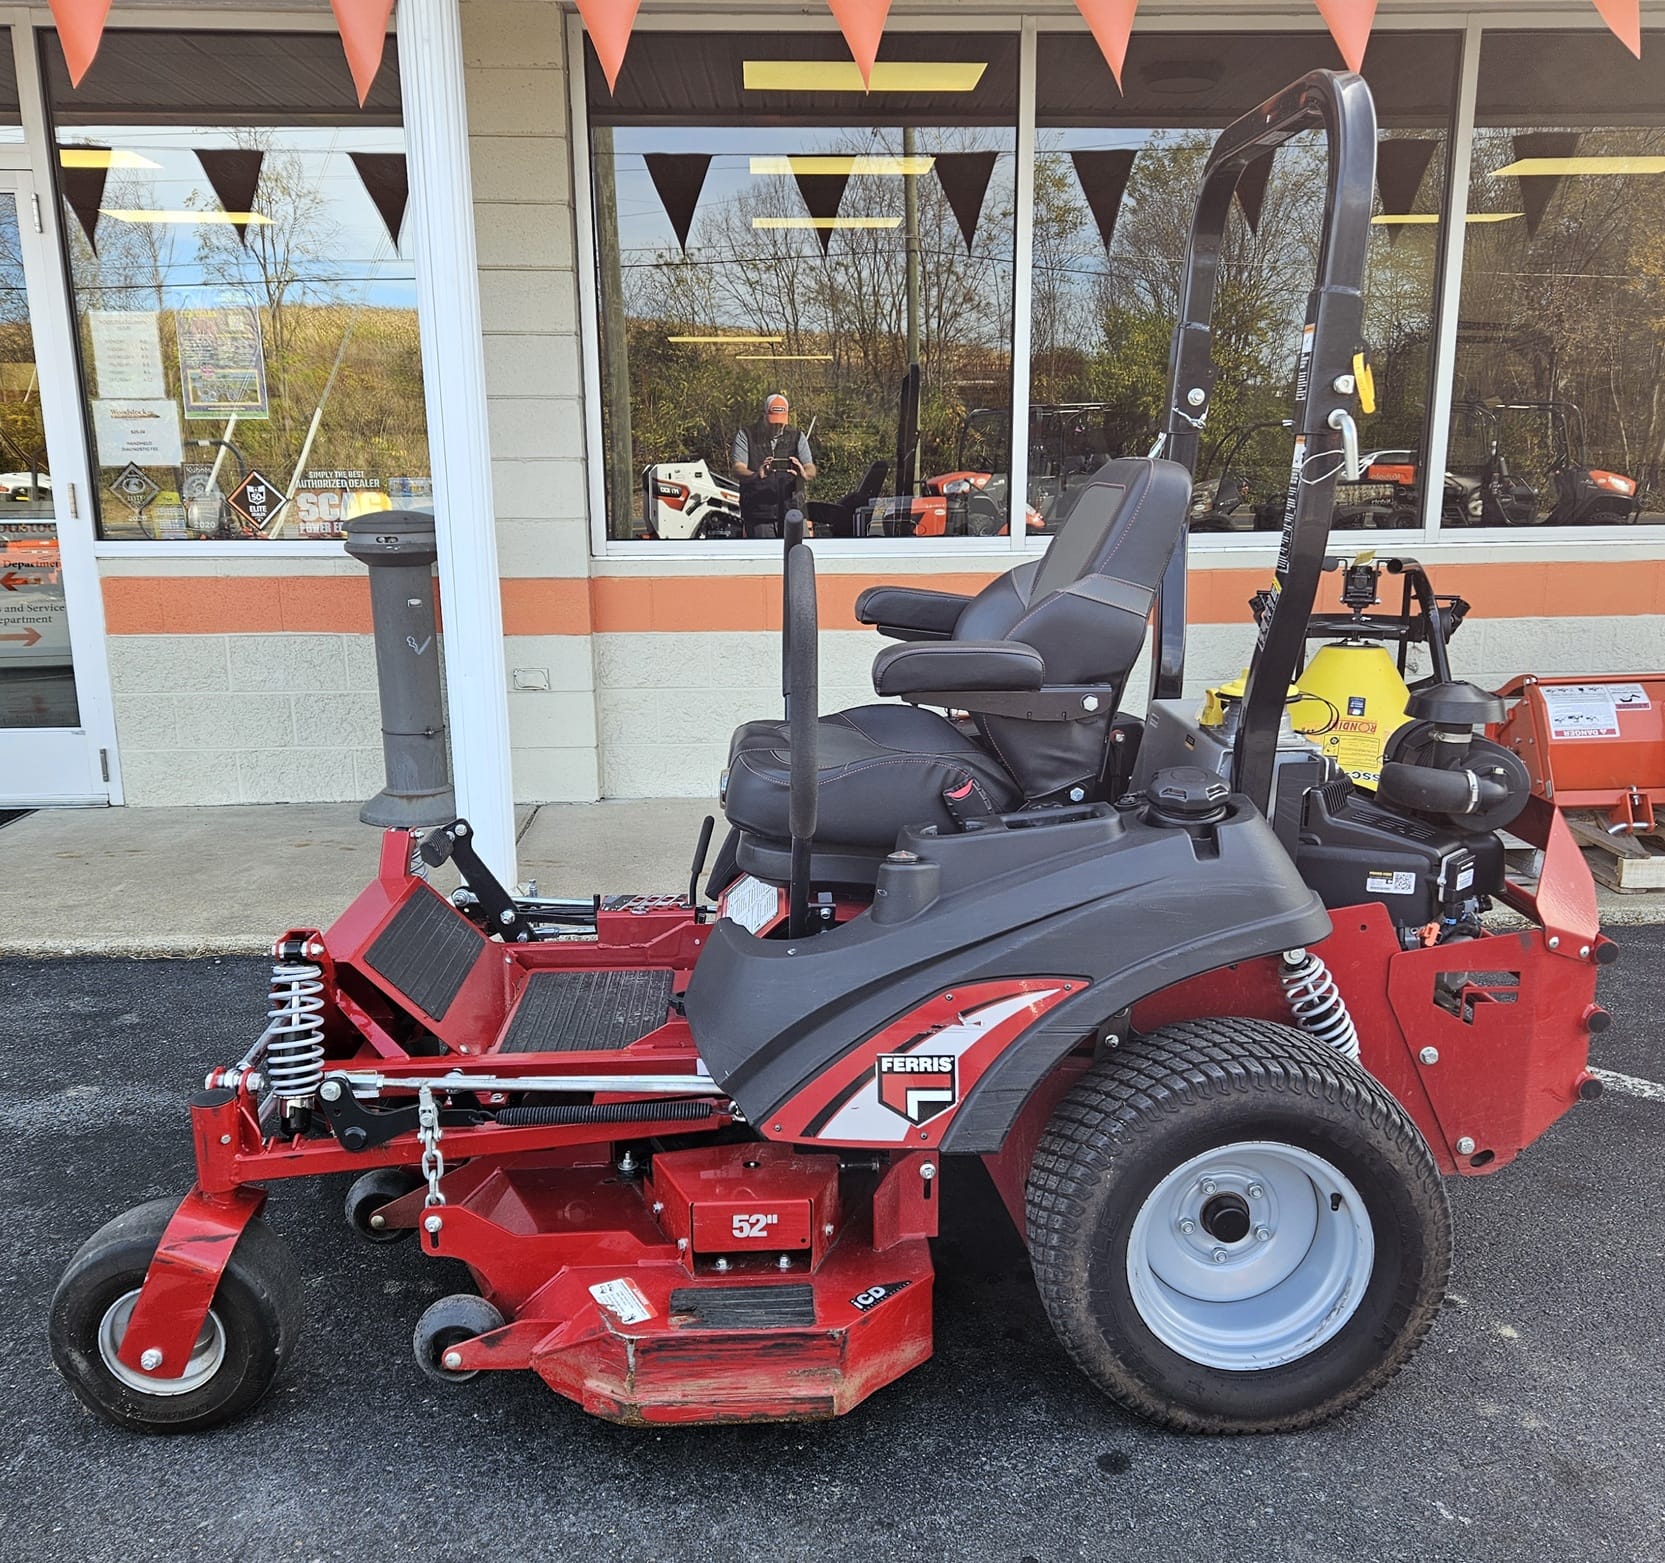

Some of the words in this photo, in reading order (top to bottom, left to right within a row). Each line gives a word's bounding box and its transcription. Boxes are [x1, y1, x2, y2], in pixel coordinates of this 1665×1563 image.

[308, 471, 333, 479] SIMPLY
[348, 470, 365, 478] BEST
[297, 480, 347, 488] AUTHORIZED
[348, 479, 380, 488] DEALER
[194, 521, 216, 529] 2020
[300, 522, 331, 533] POWER
[4, 604, 24, 613] and
[26, 603, 65, 613] Service
[881, 1057, 953, 1073] FERRIS
[732, 1214, 778, 1238] 52"
